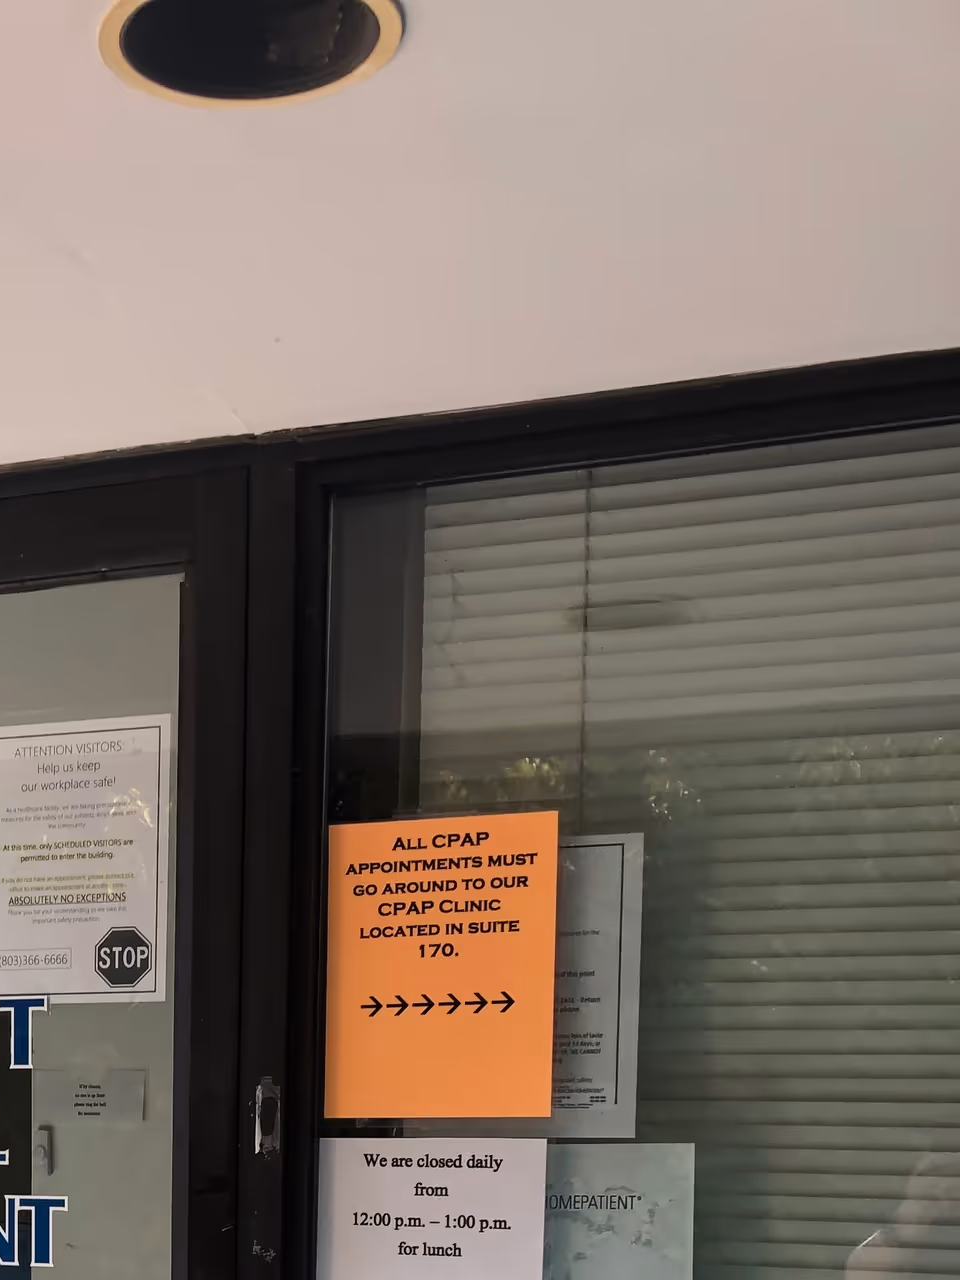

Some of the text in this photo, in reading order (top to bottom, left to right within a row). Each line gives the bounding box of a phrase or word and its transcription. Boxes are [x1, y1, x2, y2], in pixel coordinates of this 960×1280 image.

[14, 744, 73, 758] ATTENTION
[37, 761, 100, 775] Help us keep
[21, 776, 116, 792] our workplace safe!
[11, 843, 22, 851] this
[39, 842, 52, 851] only
[53, 840, 92, 849] SCHEDULED
[92, 839, 122, 847] VISITORS
[392, 832, 490, 851] ALL CPAP
[20, 854, 50, 863] permitted
[345, 852, 538, 876] APPOINTMENTS MUST
[353, 876, 529, 896] GO AROUND TO OUR
[8, 892, 126, 906] ABSOLUTELY NO EXCEPTIONS
[378, 899, 501, 916] CPAP CLINIC
[360, 920, 520, 939] LOCATED IN SUITE
[99, 946, 148, 969] STOP
[419, 943, 459, 958] 170.
[363, 1153, 503, 1172] We are closed daily
[414, 1182, 449, 1196] from
[353, 1212, 391, 1226] 12:00
[394, 1216, 426, 1230] p.m.
[444, 1214, 475, 1228] 1:00
[479, 1218, 512, 1232] p.m.
[398, 1242, 462, 1257] for lunch
